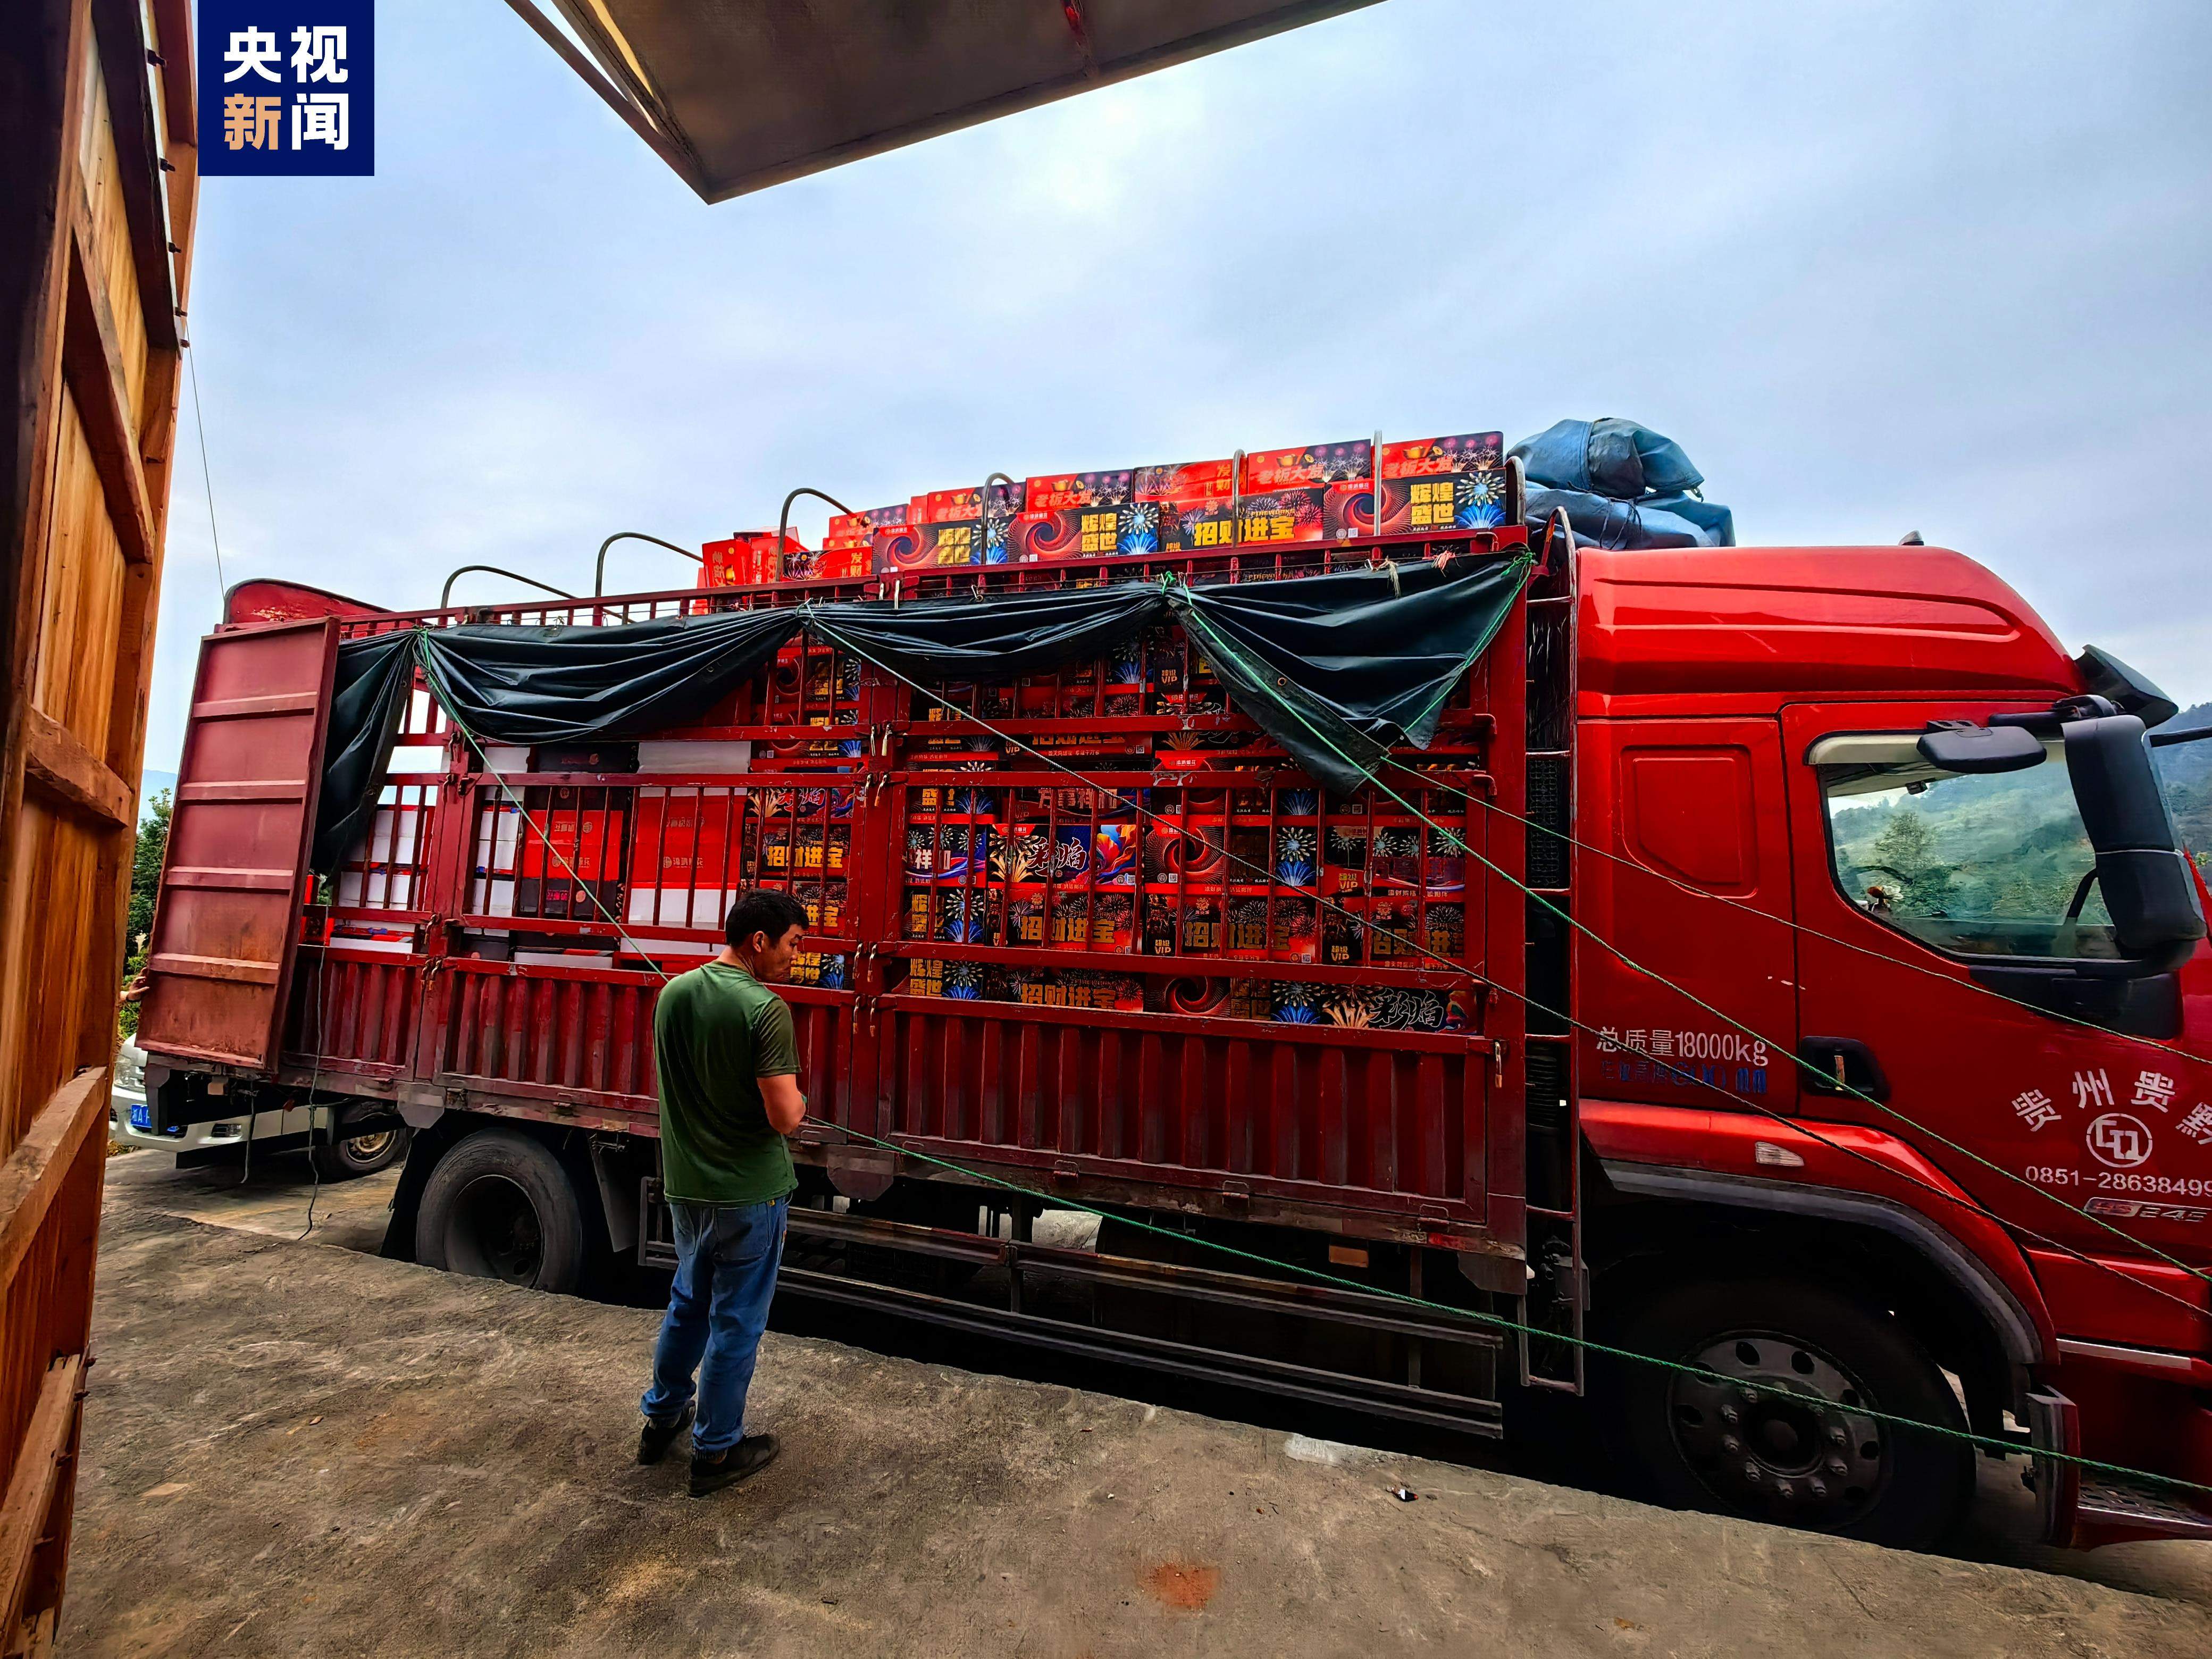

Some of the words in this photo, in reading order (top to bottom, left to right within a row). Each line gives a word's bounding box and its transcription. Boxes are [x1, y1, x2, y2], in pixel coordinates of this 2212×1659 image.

[1410, 482, 1454, 504] 辉煌
[1411, 504, 1454, 525] 盛世
[1339, 881, 1358, 890] VIP
[1154, 946, 1171, 954] VIP
[1596, 1026, 1768, 1067] 总质量18000kg
